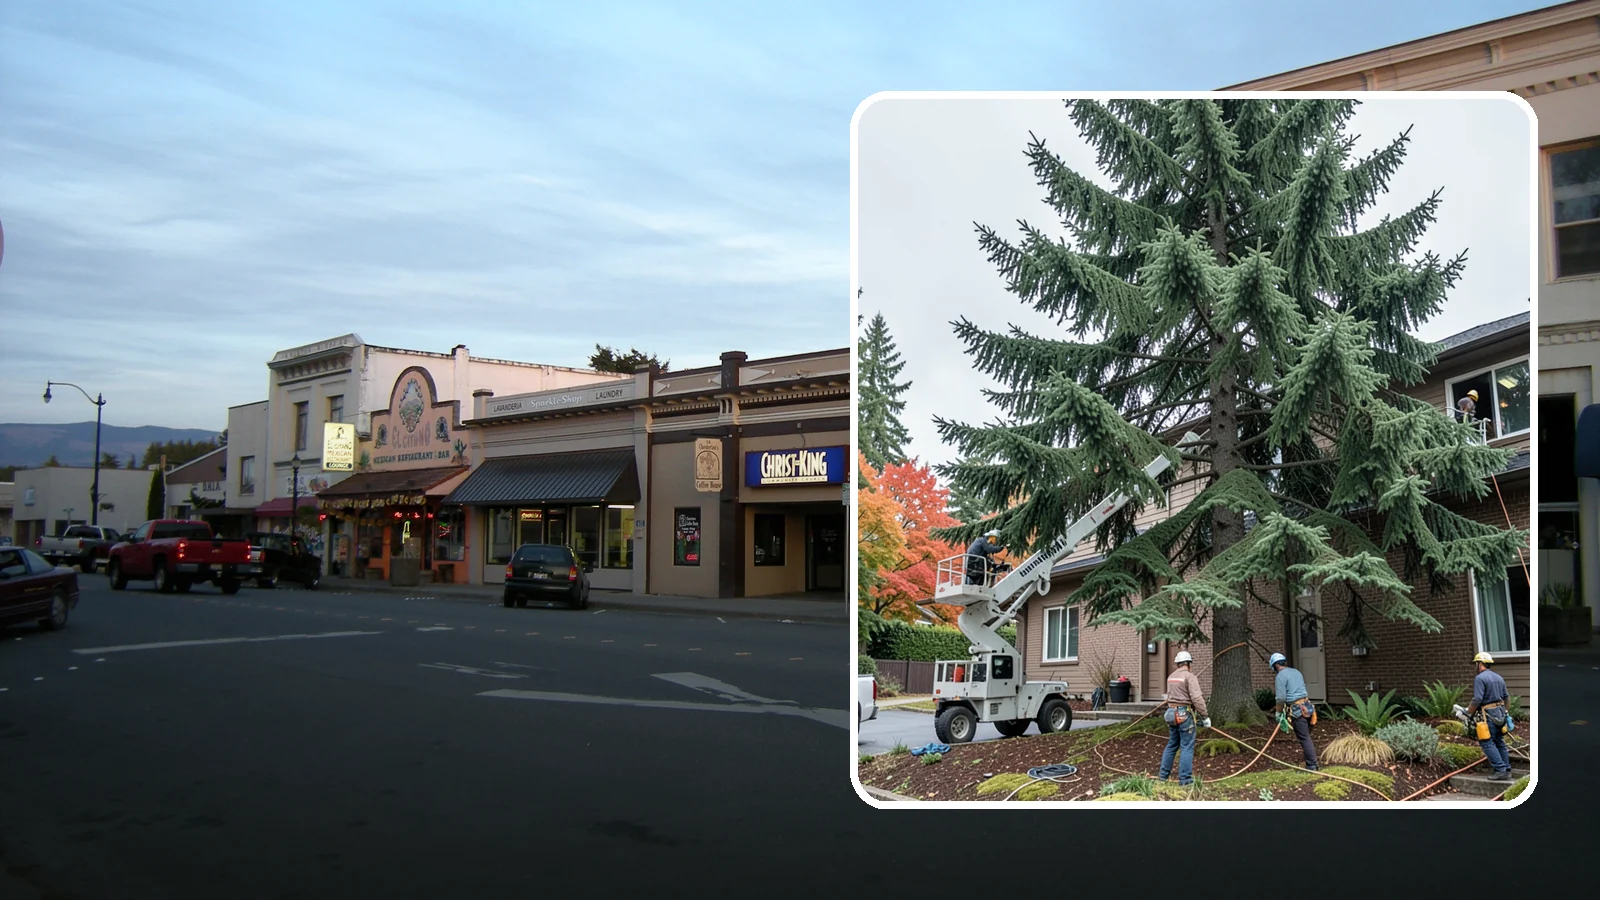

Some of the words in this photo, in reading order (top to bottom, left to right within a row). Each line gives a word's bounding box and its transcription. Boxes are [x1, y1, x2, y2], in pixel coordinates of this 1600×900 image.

[595, 389, 624, 400] LAUNDRY
[493, 402, 523, 413] LAVANDERIA
[391, 426, 401, 449] EL
[374, 454, 396, 464] MEXICAN
[397, 451, 433, 462] RESTAURANT
[438, 450, 450, 459] BAR
[761, 452, 797, 478] CHRIST
[799, 450, 827, 477] KING
